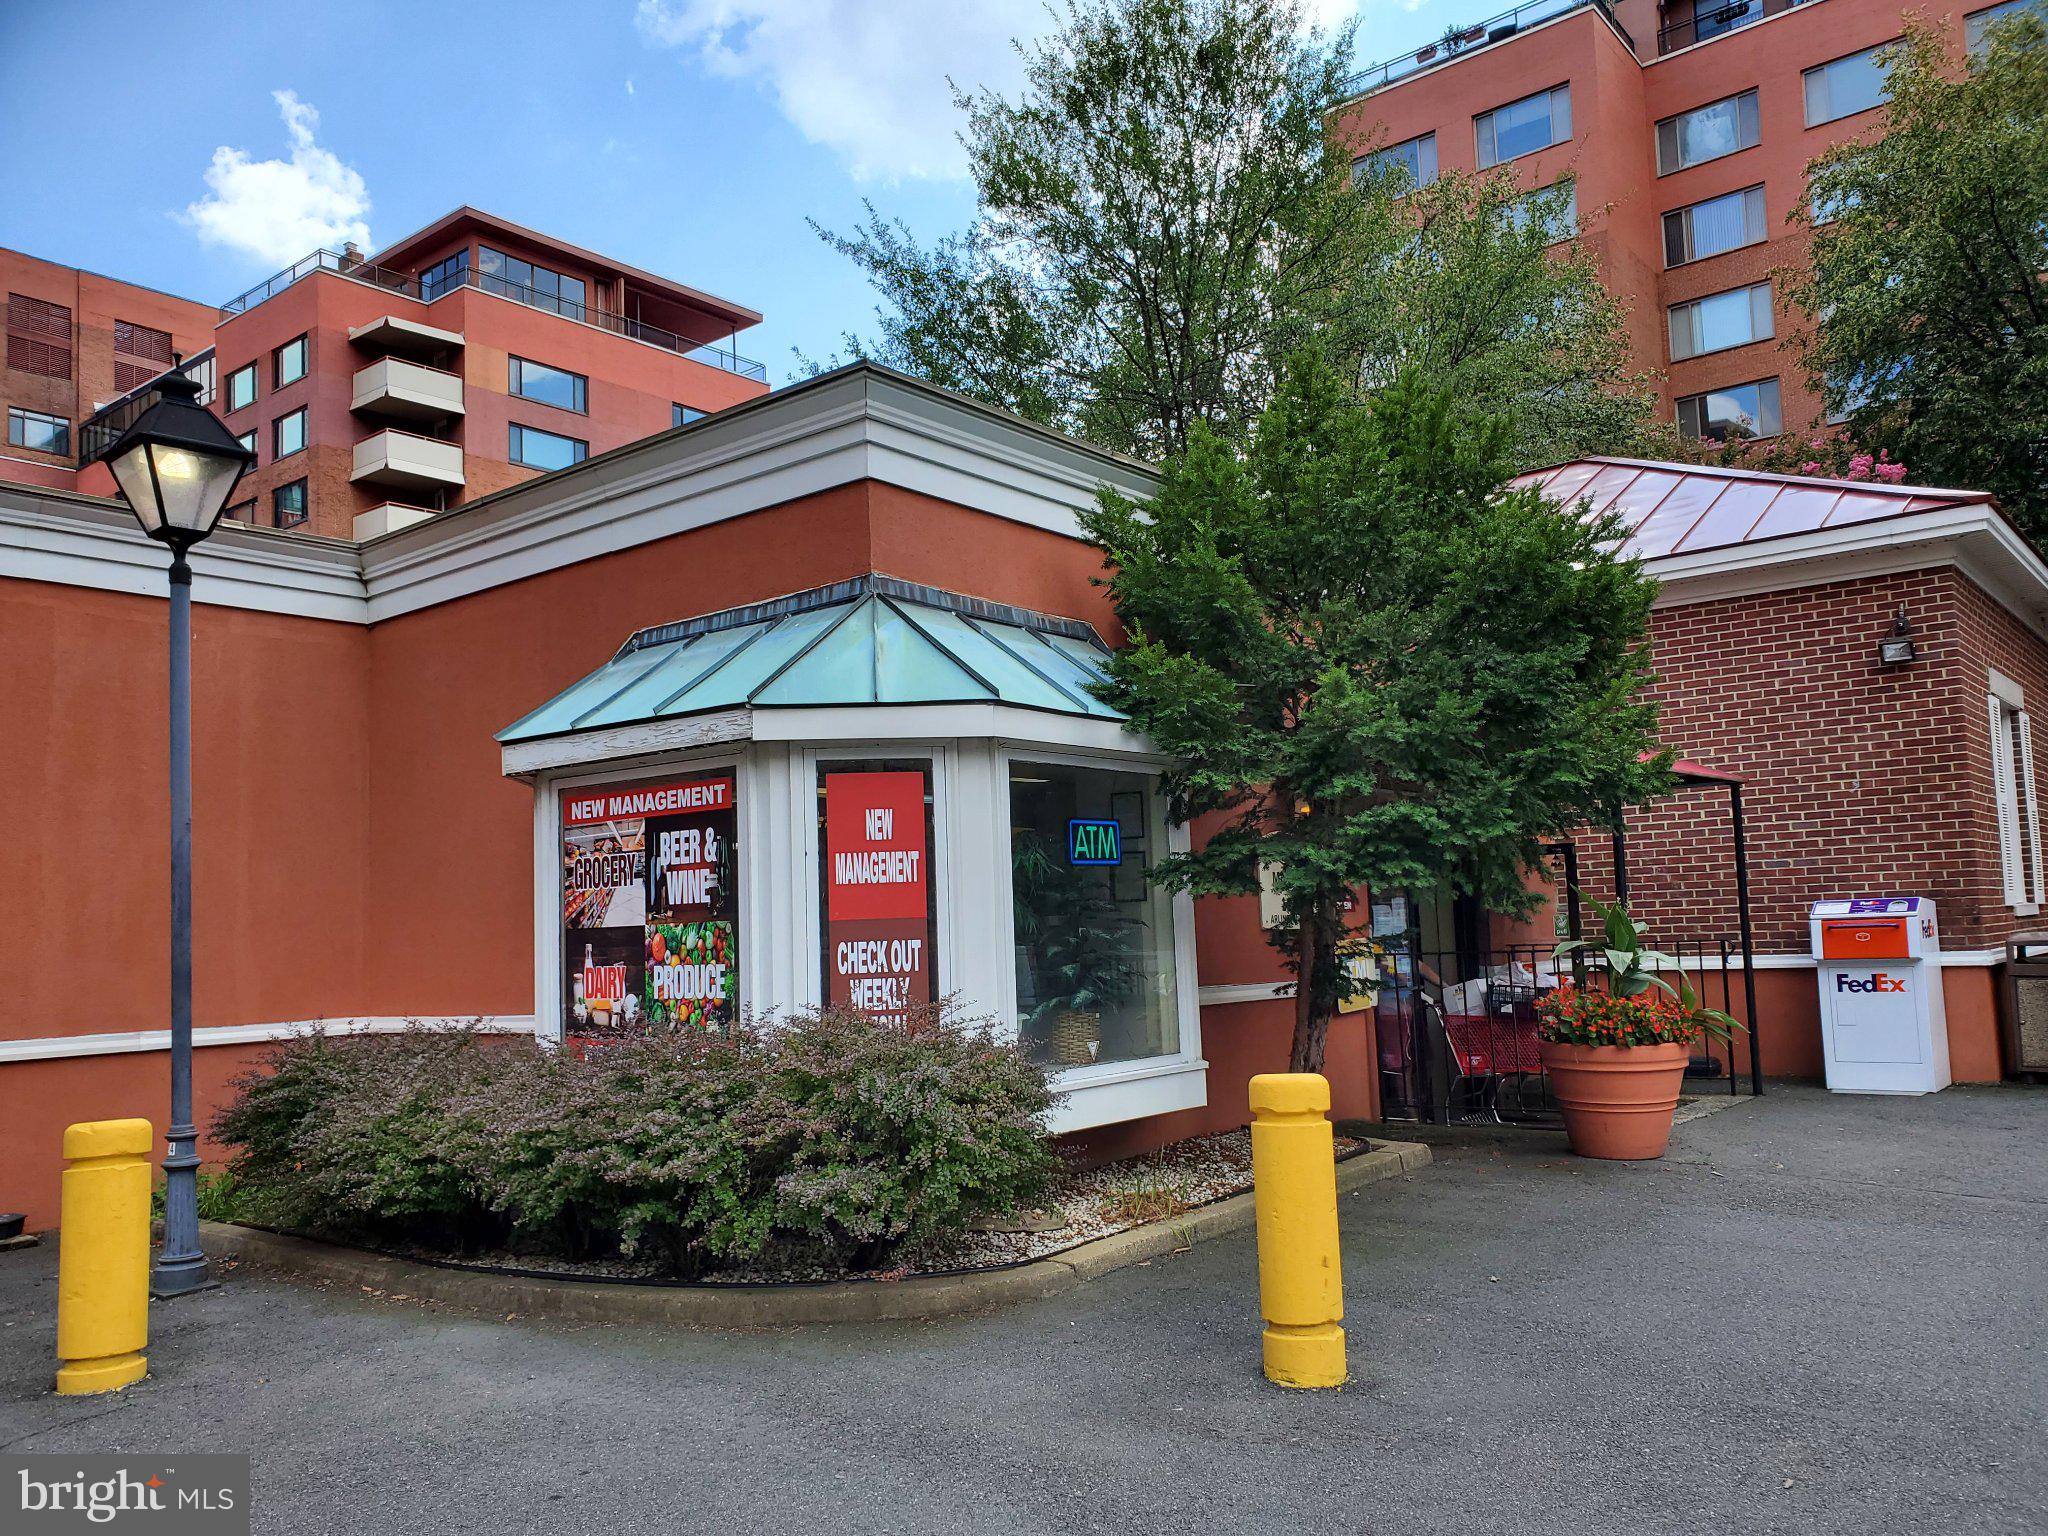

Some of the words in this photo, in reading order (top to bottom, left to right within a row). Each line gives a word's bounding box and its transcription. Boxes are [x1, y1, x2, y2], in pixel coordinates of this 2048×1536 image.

[571, 799, 605, 820] NEW
[609, 784, 725, 815] MANAGEMENT
[865, 808, 893, 841] NEW
[1074, 825, 1117, 859] ATM
[660, 829, 700, 867] BEER
[704, 826, 717, 862] &
[574, 853, 636, 891] GROCERY
[835, 850, 919, 885] MANAGEMENT
[667, 868, 711, 905] WINE
[837, 940, 889, 975] CHECK
[891, 939, 922, 973] OUT
[585, 967, 626, 999] DAIRY
[653, 964, 727, 999] PRODUCE
[849, 976, 911, 1012] WEEKLY
[1836, 973, 1907, 994] FedEx
